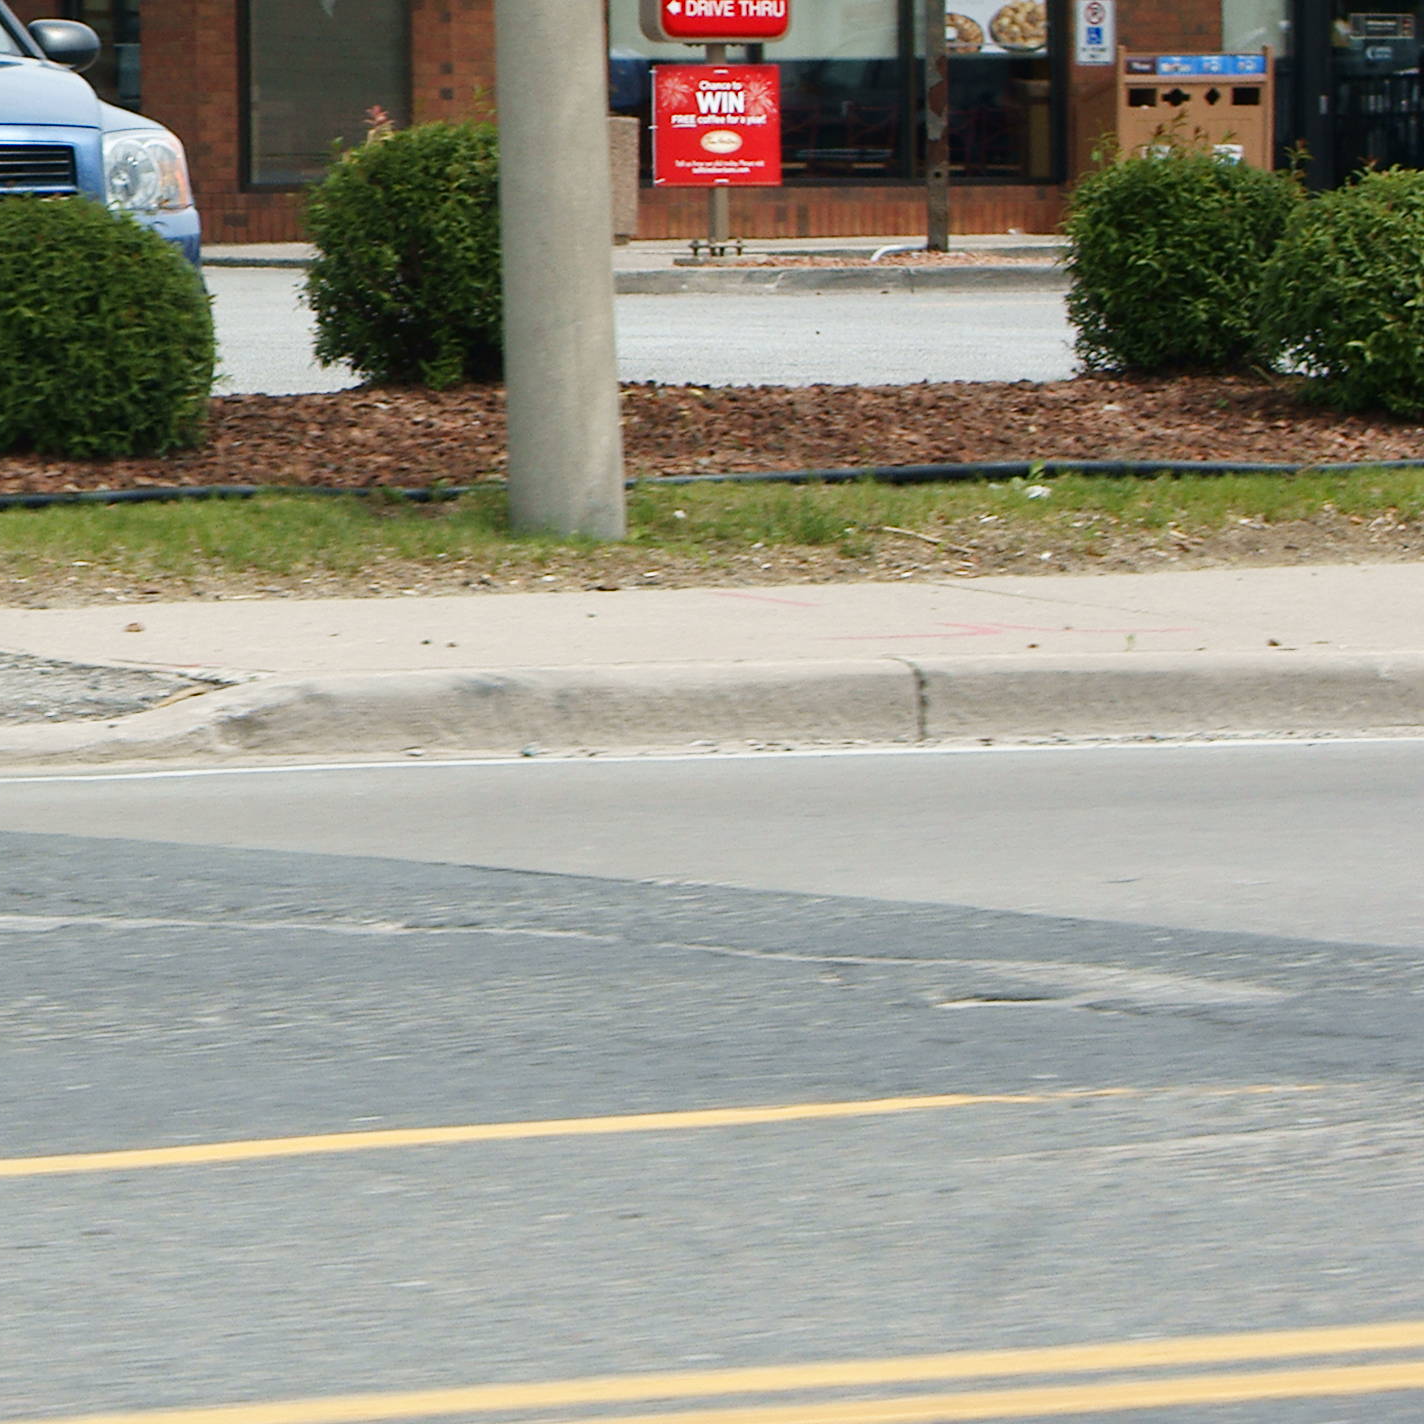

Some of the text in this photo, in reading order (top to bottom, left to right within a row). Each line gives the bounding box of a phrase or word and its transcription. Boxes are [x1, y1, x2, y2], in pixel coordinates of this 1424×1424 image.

[685, 0, 785, 17] DRIVE THRU
[695, 91, 745, 114] WIN
[671, 114, 697, 124] FREE
